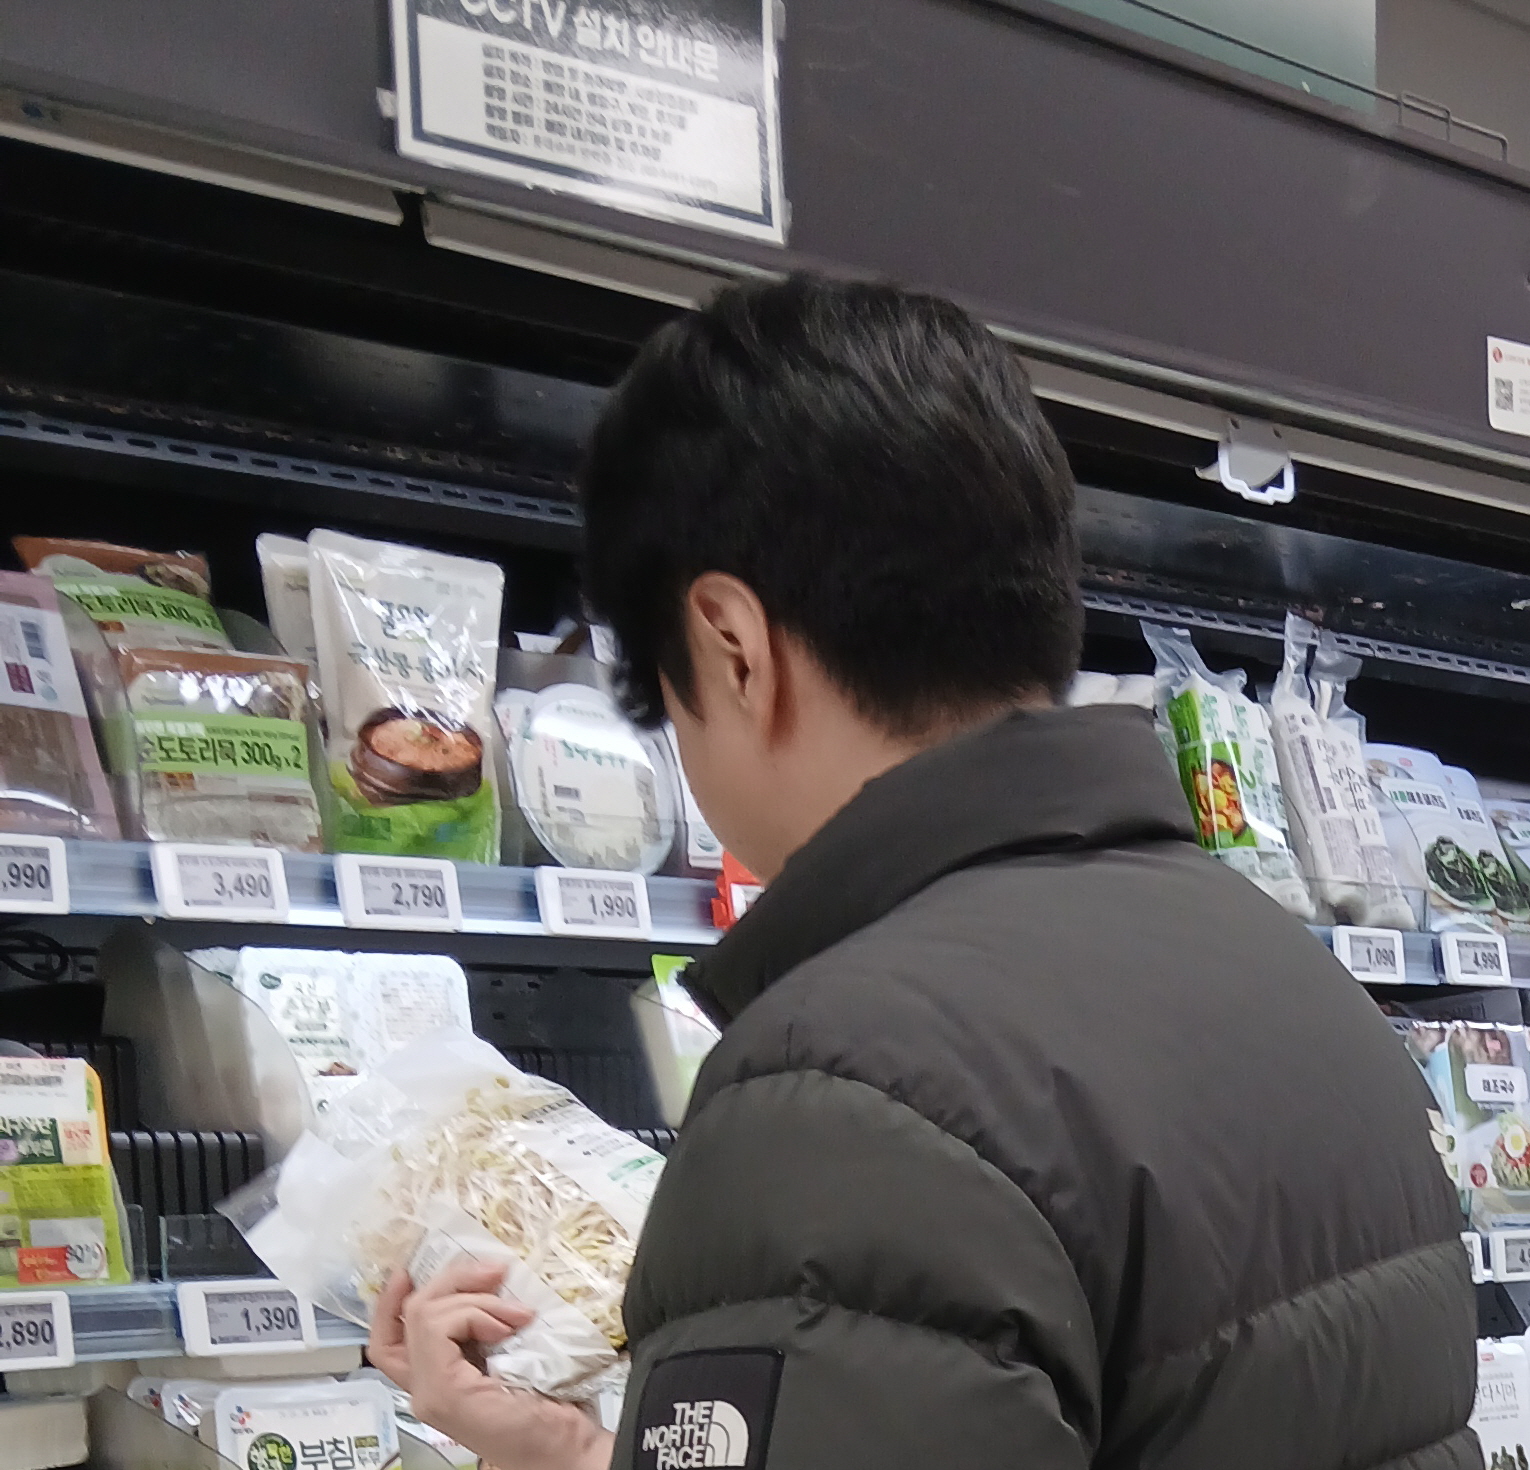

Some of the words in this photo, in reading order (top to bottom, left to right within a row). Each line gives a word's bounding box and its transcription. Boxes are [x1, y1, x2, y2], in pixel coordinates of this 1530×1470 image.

[571, 6, 630, 58] 설치
[634, 25, 720, 83] 안내문
[1, 862, 51, 890] ,990
[212, 871, 272, 899] 3,490
[391, 882, 445, 909] 2,790
[589, 893, 637, 920] 1,990
[1365, 946, 1396, 968] 1,090
[1472, 950, 1501, 970] 4,990
[243, 1306, 299, 1332] 1,390
[672, 1401, 714, 1426] THE
[641, 1421, 710, 1452] NORTH
